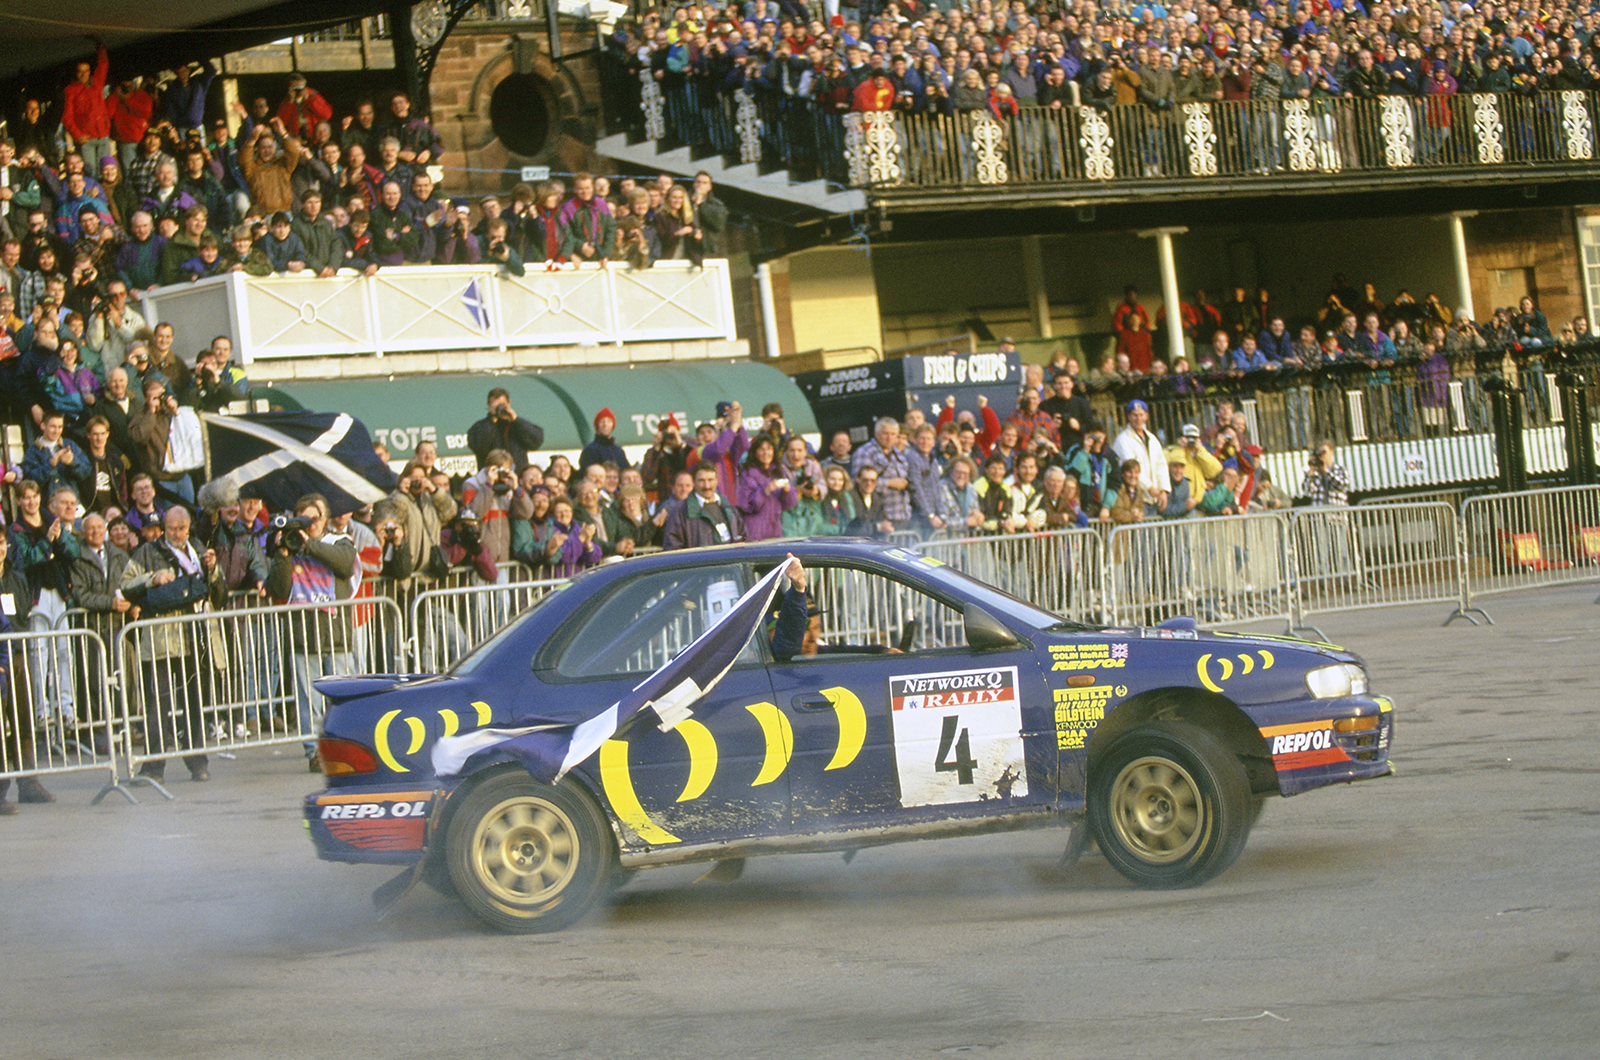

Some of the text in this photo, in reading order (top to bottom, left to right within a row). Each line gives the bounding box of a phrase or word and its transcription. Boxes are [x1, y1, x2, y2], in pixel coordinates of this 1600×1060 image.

[826, 367, 870, 384] JUMBO
[923, 353, 1008, 385] FISH & CHIPS
[820, 378, 878, 397] HOT DOGS
[374, 426, 438, 451] TOTE
[440, 457, 476, 471] Betting
[1048, 644, 1110, 653] DEREK RINGER
[1052, 652, 1079, 660] COLIN
[1051, 658, 1126, 671] REPSOL
[902, 671, 1002, 693] NETWORK Q
[925, 689, 1003, 708] RALLY
[1053, 685, 1114, 702] PIRELLI
[1071, 699, 1107, 710] TURBO
[1054, 706, 1105, 723] BILSTEIN
[1056, 720, 1098, 731] KENWOOD
[1056, 729, 1088, 739] PIAA
[934, 715, 978, 785] 4
[1057, 737, 1085, 747] NGK
[1272, 729, 1332, 755] REPSOL
